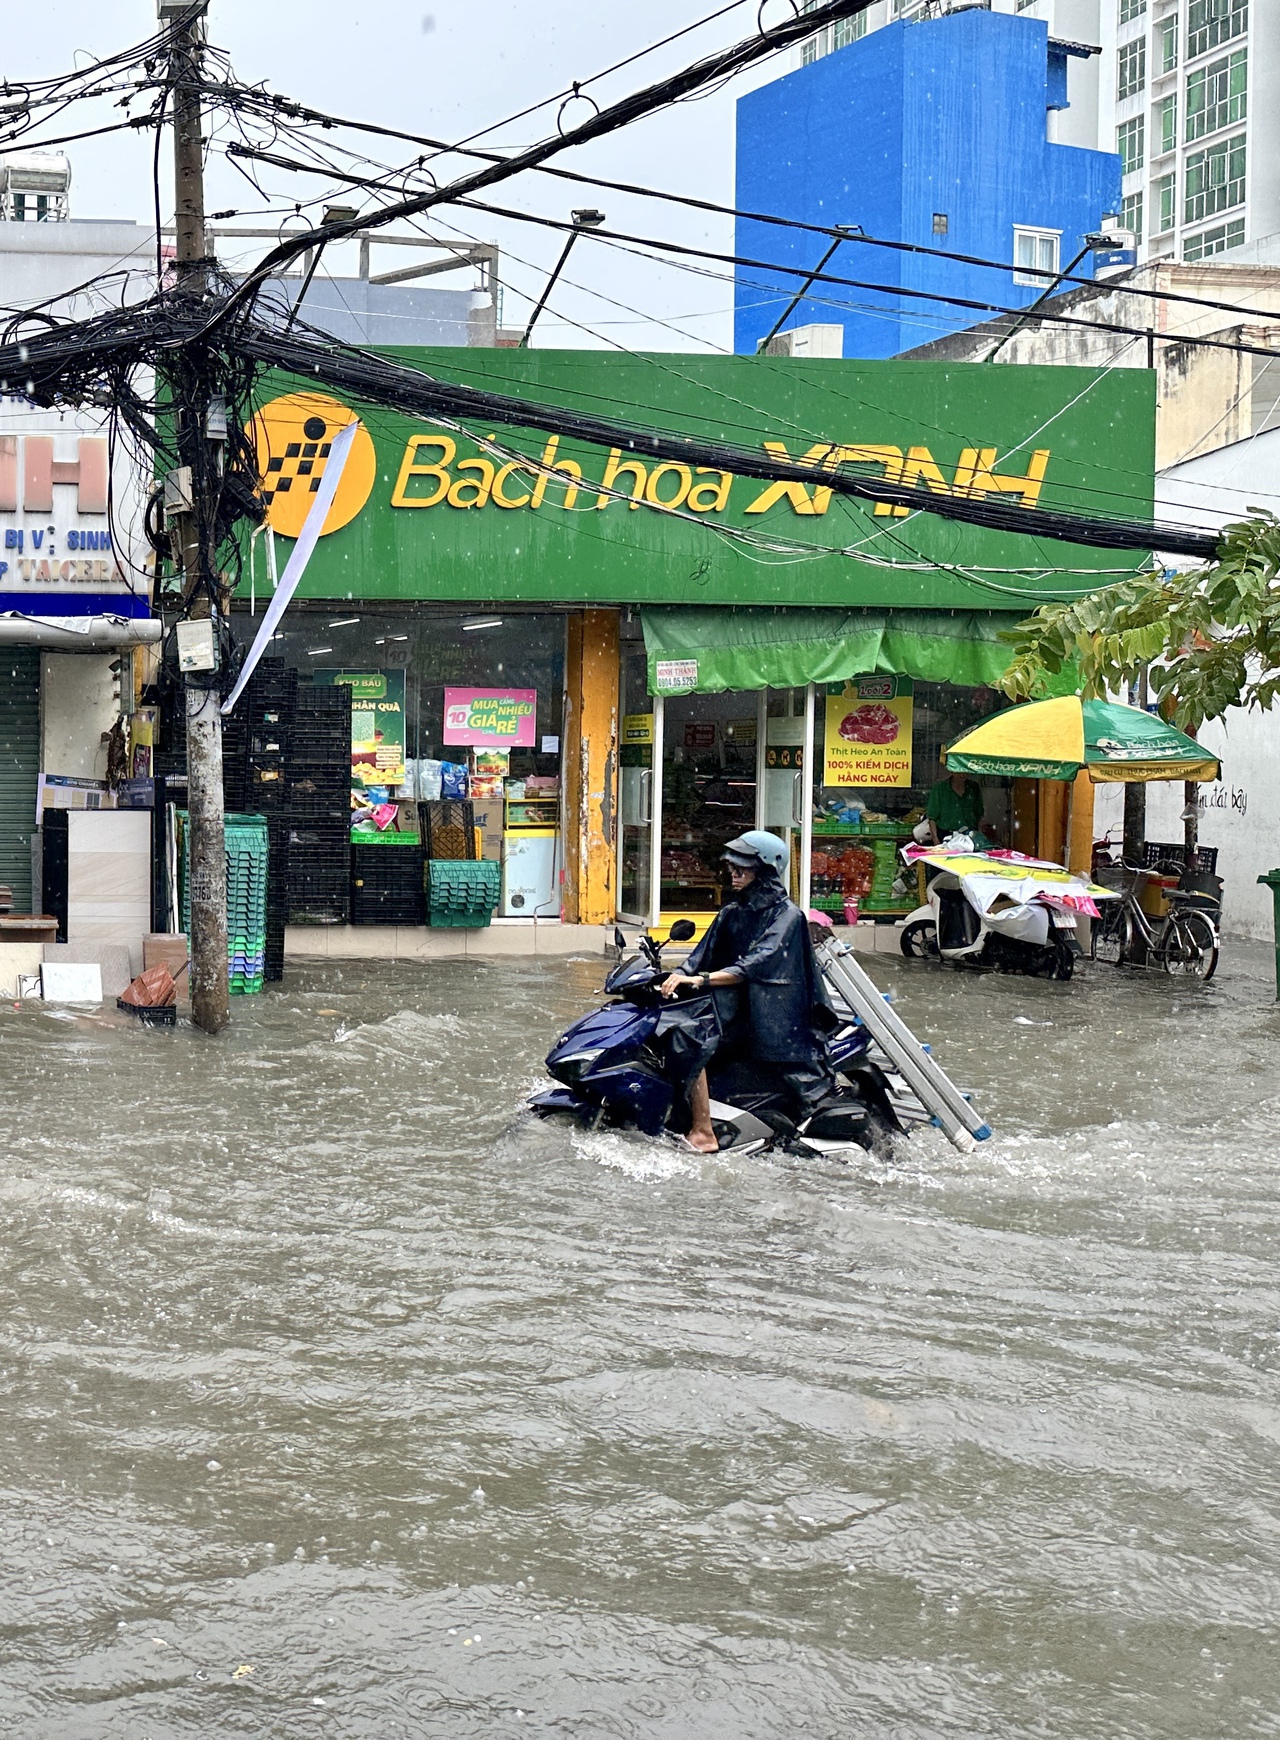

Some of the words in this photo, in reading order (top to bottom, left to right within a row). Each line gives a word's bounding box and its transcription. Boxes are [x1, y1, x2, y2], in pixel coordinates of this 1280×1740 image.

[391, 433, 583, 510] Bách
[5, 529, 24, 554] BỊ
[67, 530, 112, 550] SINH
[18, 558, 125, 582] TAICERA
[882, 684, 891, 695] 2
[378, 701, 401, 713] QUÀ
[472, 700, 499, 710] MUA
[449, 711, 467, 724] 10
[470, 711, 497, 728] GIÁ
[496, 716, 517, 734] RẺ
[830, 747, 848, 757] Thịt
[850, 748, 869, 756] Heo
[870, 748, 883, 756] An
[885, 748, 907, 756] Toàn
[828, 760, 854, 769] 100%
[855, 758, 881, 769] KIỂM
[884, 761, 909, 772] DỊCH
[1016, 762, 1062, 775] XANH
[870, 773, 899, 783] NGÀY
[1231, 784, 1248, 816] bậy
[473, 812, 489, 824] urf
